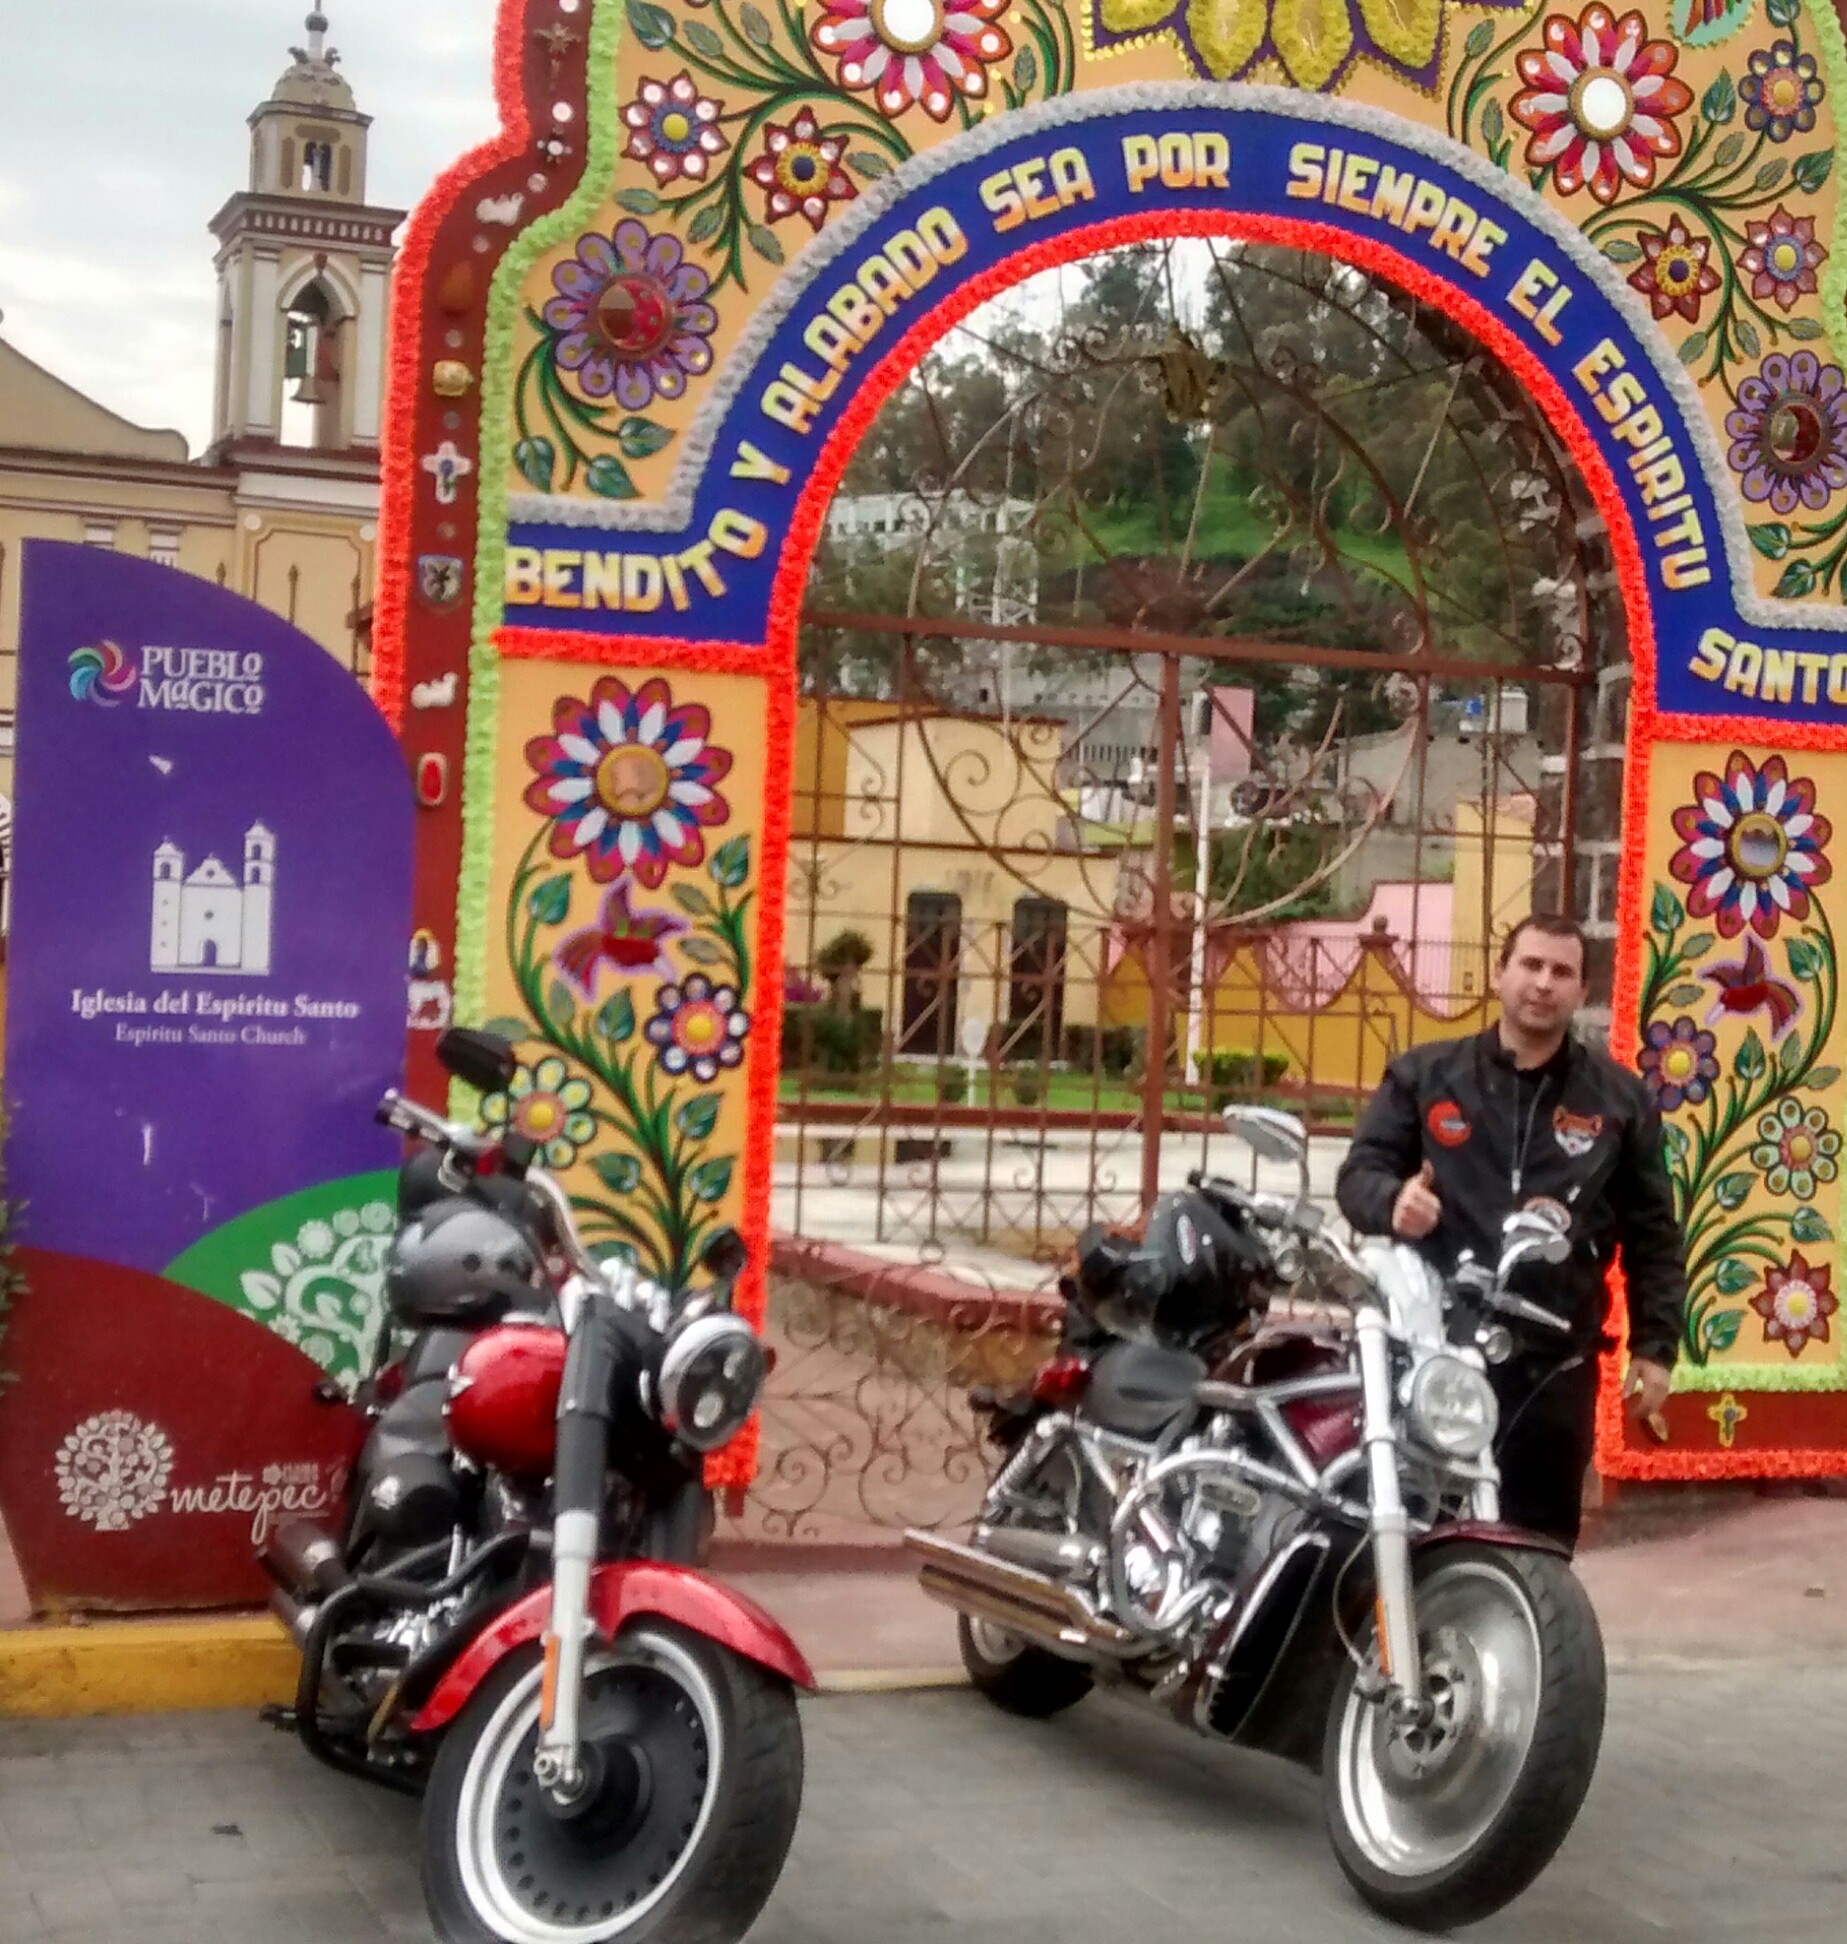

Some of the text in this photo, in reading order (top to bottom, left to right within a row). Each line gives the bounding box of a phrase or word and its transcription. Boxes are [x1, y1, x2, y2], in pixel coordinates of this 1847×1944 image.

[506, 132, 1847, 704] BENDITO Y ALABADO SEA POR SIEMPRE EL ESPIRITU SANTO
[72, 989, 147, 1019] Iglesia
[153, 990, 190, 1014] del
[294, 995, 360, 1018] Santo
[188, 1025, 236, 1043] Santo
[241, 1026, 306, 1045] Church
[169, 1470, 327, 1545] metepec
